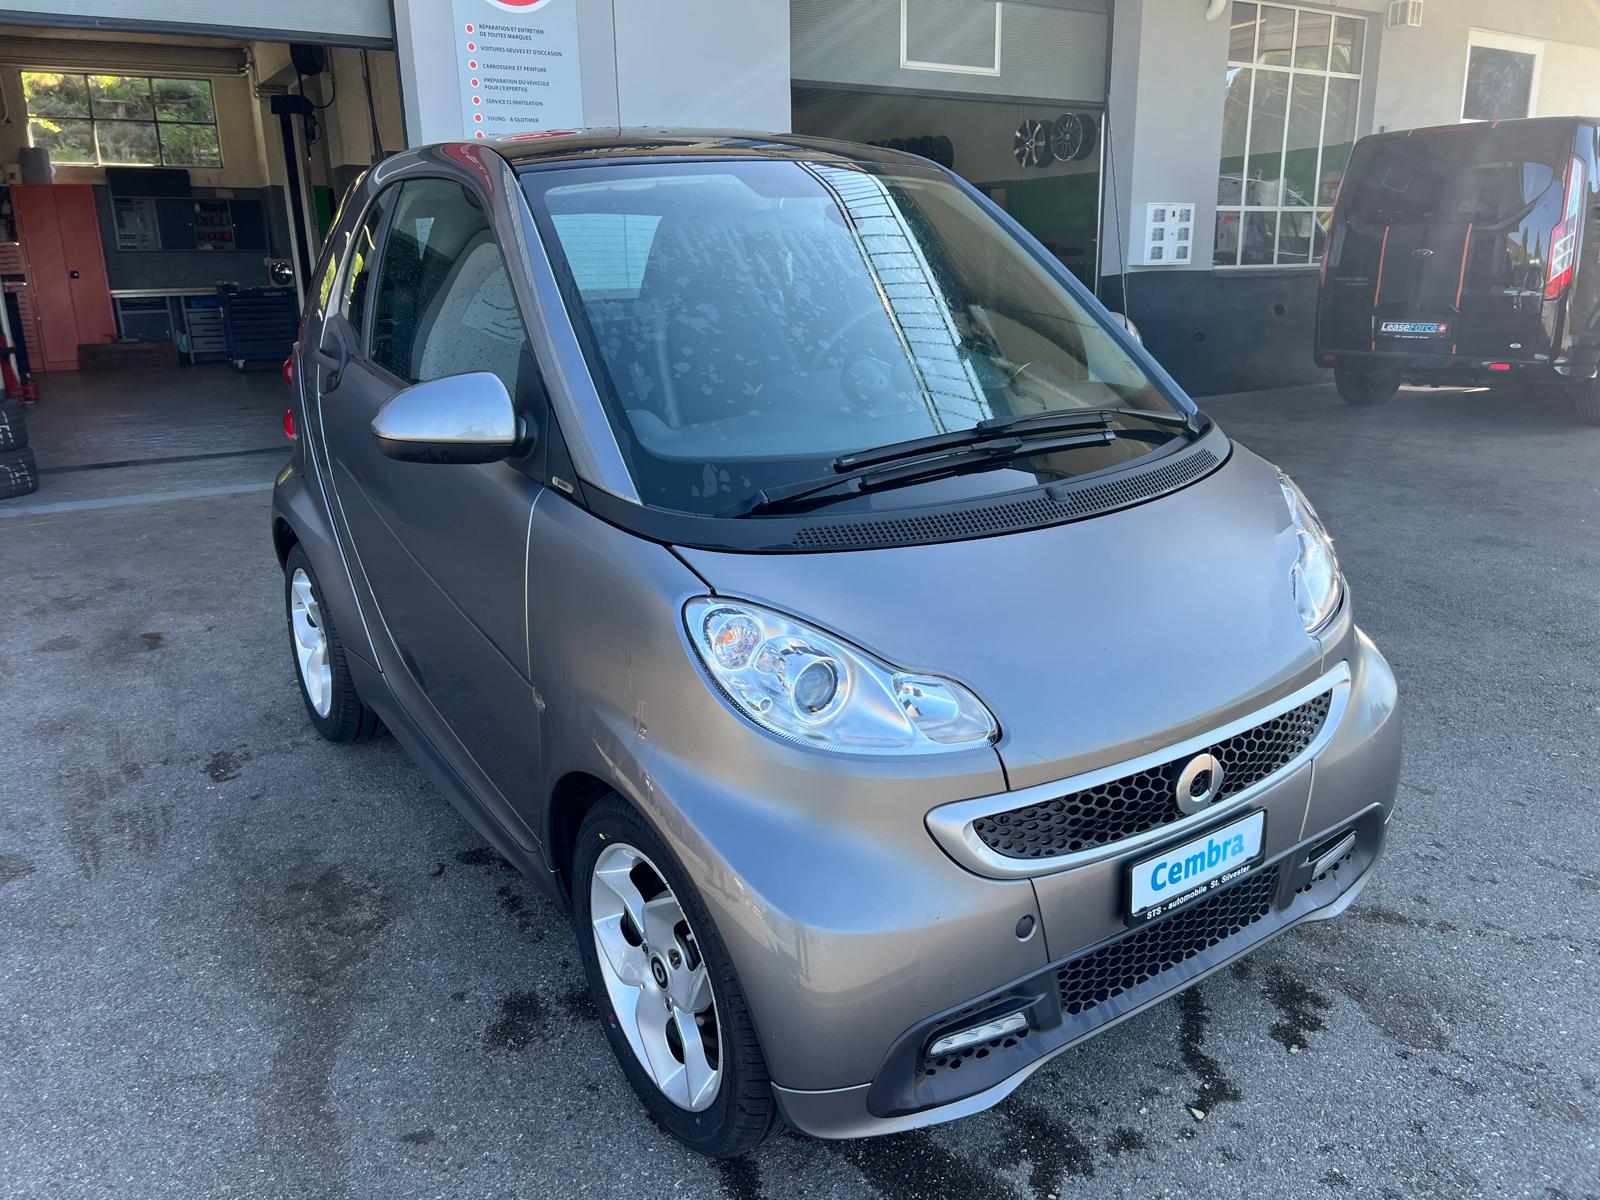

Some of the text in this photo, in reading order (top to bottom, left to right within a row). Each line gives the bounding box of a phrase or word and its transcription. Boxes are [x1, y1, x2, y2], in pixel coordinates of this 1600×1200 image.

[479, 23, 511, 32] RÉPARATION
[482, 63, 516, 71] CARROSSERIE
[1381, 322, 1438, 333] LeaseForce
[1151, 834, 1244, 891] Cembra
[1146, 906, 1162, 920] STS
[1168, 885, 1207, 910] automobile
[1210, 879, 1220, 889] St.
[1221, 865, 1251, 883] Silvester
